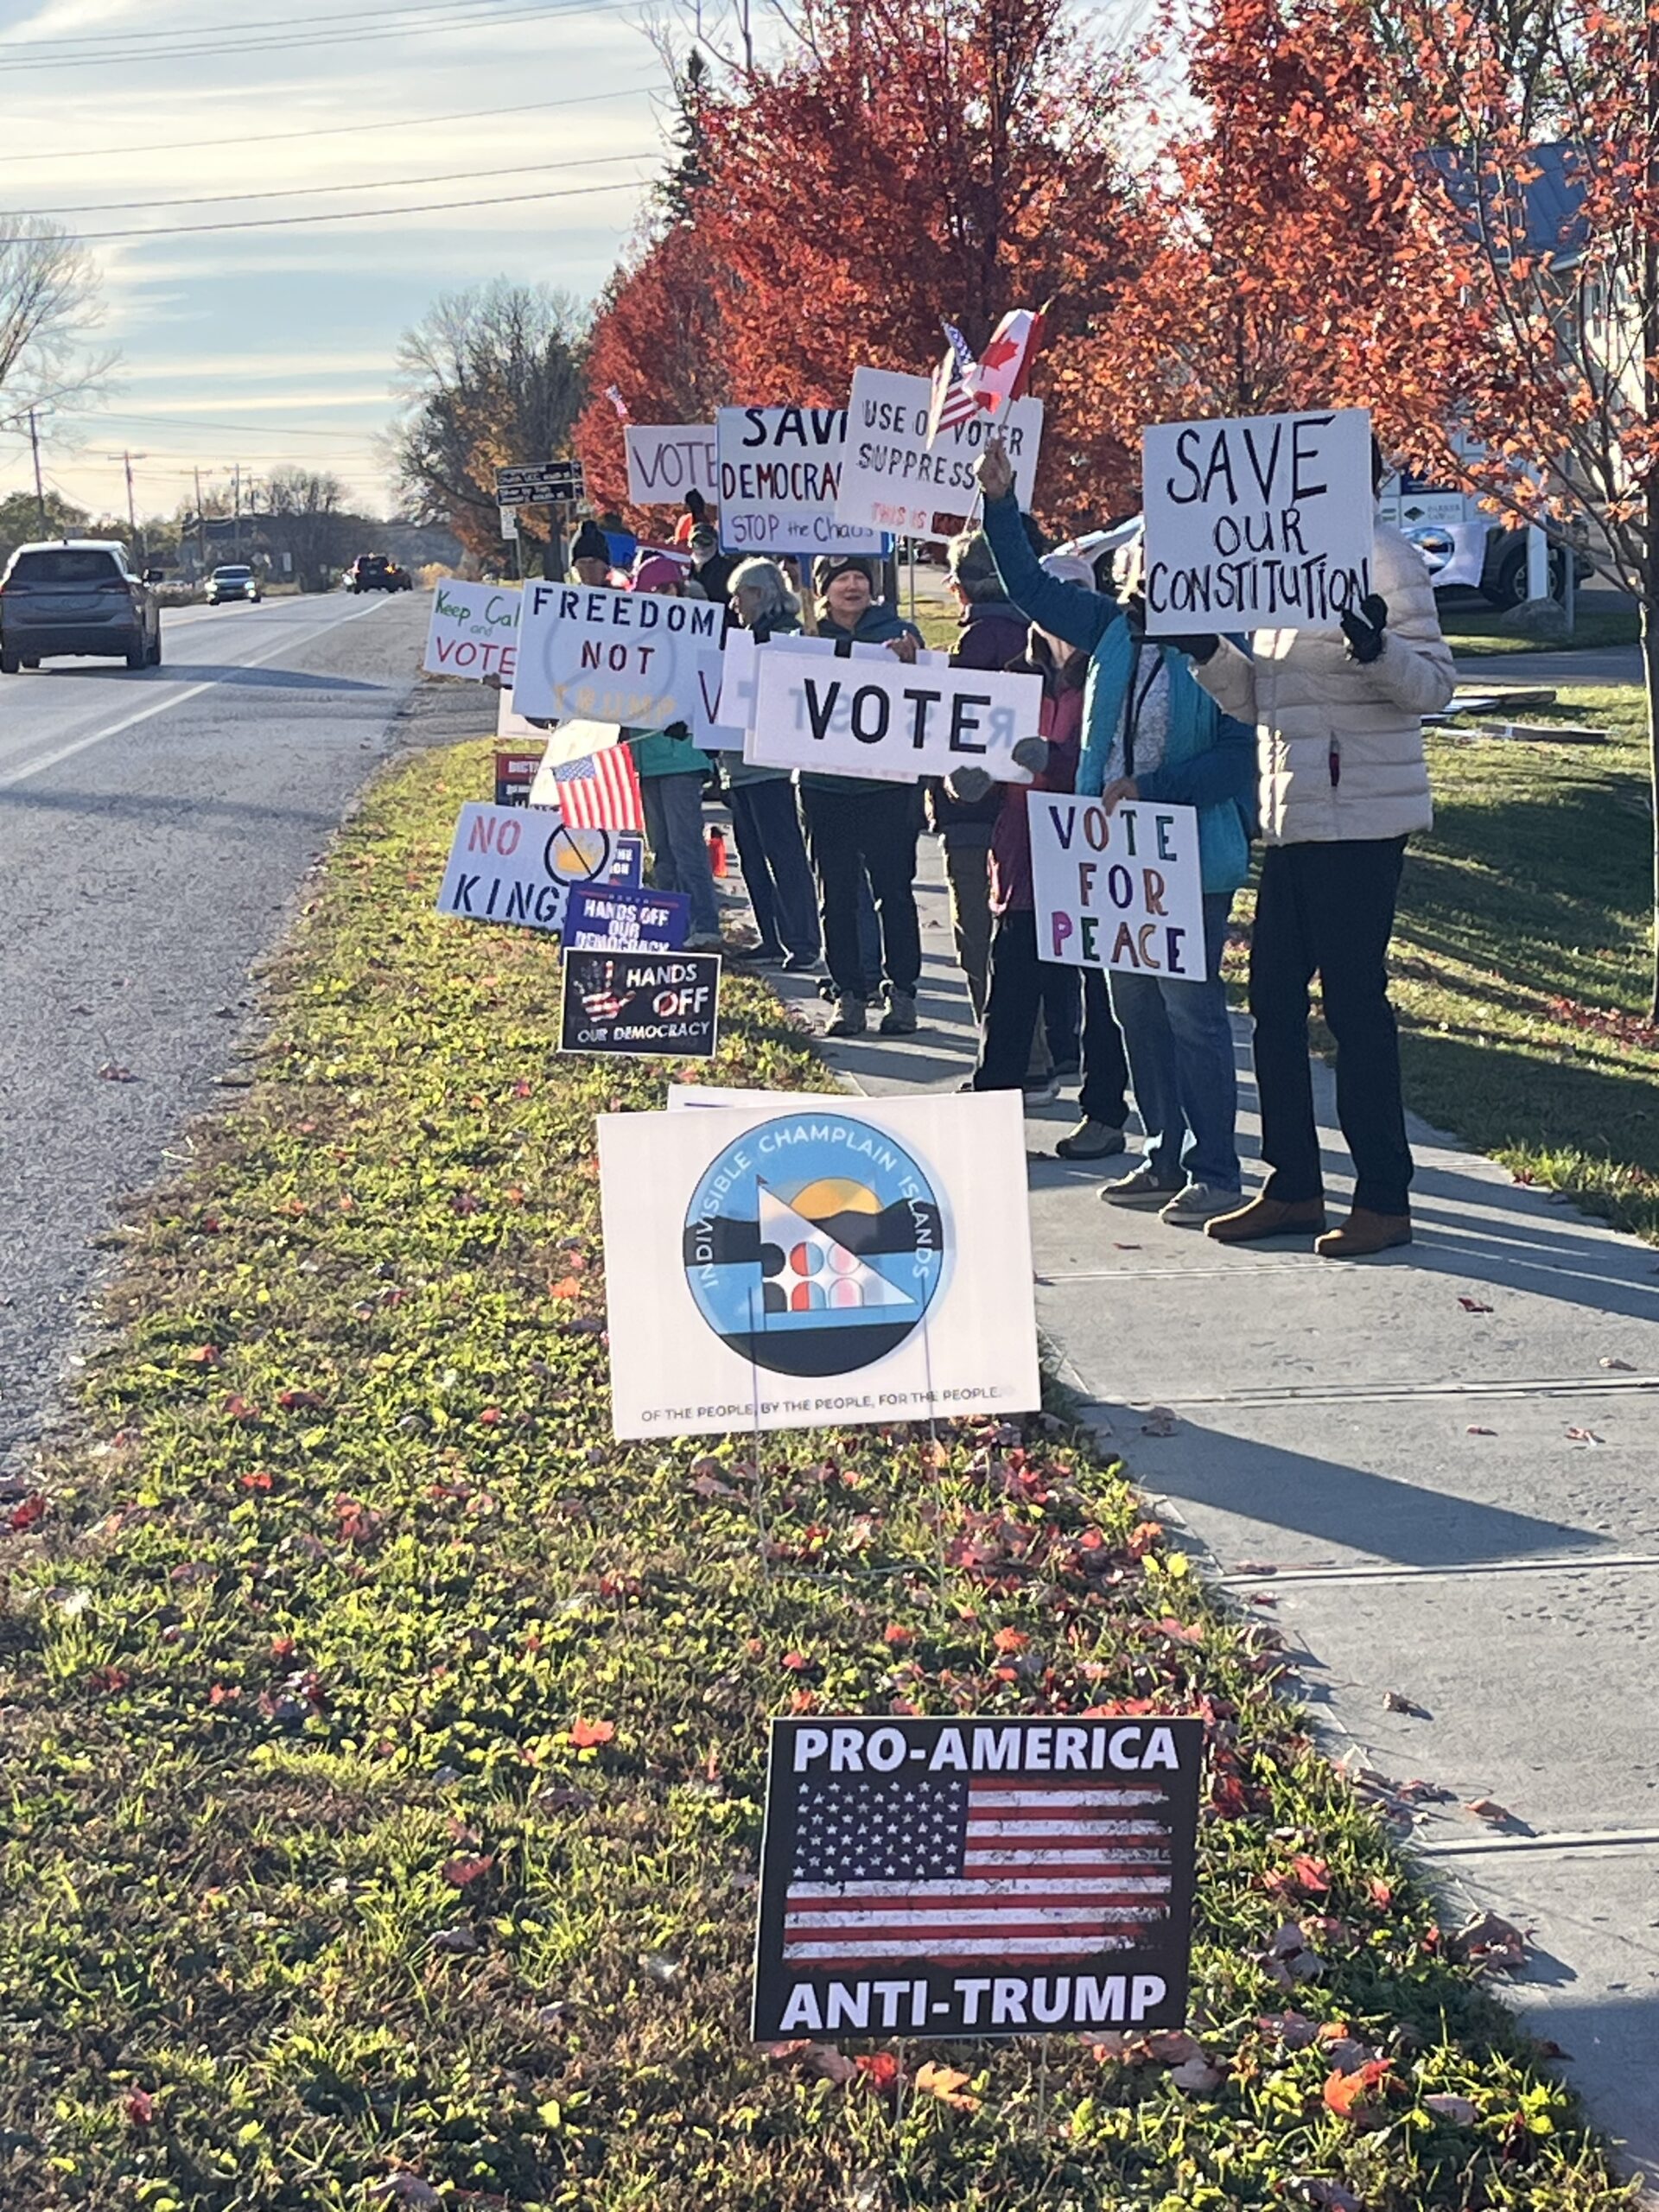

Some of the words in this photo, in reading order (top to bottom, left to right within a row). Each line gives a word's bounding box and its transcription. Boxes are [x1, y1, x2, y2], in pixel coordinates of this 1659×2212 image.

[862, 399, 906, 433] USE
[914, 410, 929, 434] O
[953, 420, 1024, 456] VOTER
[632, 442, 716, 488] VOTE
[859, 442, 1017, 493] SUPPRESS
[1166, 415, 1336, 505] SAVE
[732, 514, 779, 543] STOP
[787, 521, 810, 537] the
[910, 510, 925, 530] IS
[1213, 507, 1308, 557] OUR
[435, 589, 471, 626] Keep
[485, 595, 521, 628] Cal
[533, 587, 715, 637] FREEDOM
[437, 636, 518, 675] VOTE
[581, 640, 655, 675] NOT
[804, 677, 991, 754] VOTE
[467, 815, 522, 856] NO
[1049, 806, 1178, 861] VOTE
[452, 874, 567, 924] KING
[1078, 862, 1169, 916] FOR
[583, 899, 637, 923] HANDS
[640, 907, 670, 926] OFF
[608, 920, 640, 939] OUR
[575, 931, 670, 952] DEMOCRACY
[1052, 911, 1185, 974] PEACE
[626, 963, 697, 988] HANDS
[652, 986, 709, 1017] OFF
[577, 1027, 608, 1043] OUR
[613, 1021, 710, 1041] DEMOCRACY
[696, 1150, 752, 1288] INDIVISIBLE
[759, 1125, 898, 1173] CHAMPLAIN
[897, 1175, 934, 1280] ISLANDS
[641, 1410, 662, 1422] OF
[666, 1408, 692, 1421] THE
[760, 1402, 780, 1414] BY
[784, 1399, 810, 1412] THE
[815, 1395, 874, 1410] PEOPLE,
[879, 1392, 907, 1406] FOR
[911, 1390, 938, 1403] THE
[792, 1726, 1180, 1773] PRO-AMERICA
[779, 1974, 1168, 2031] ANTI-TRUMP
